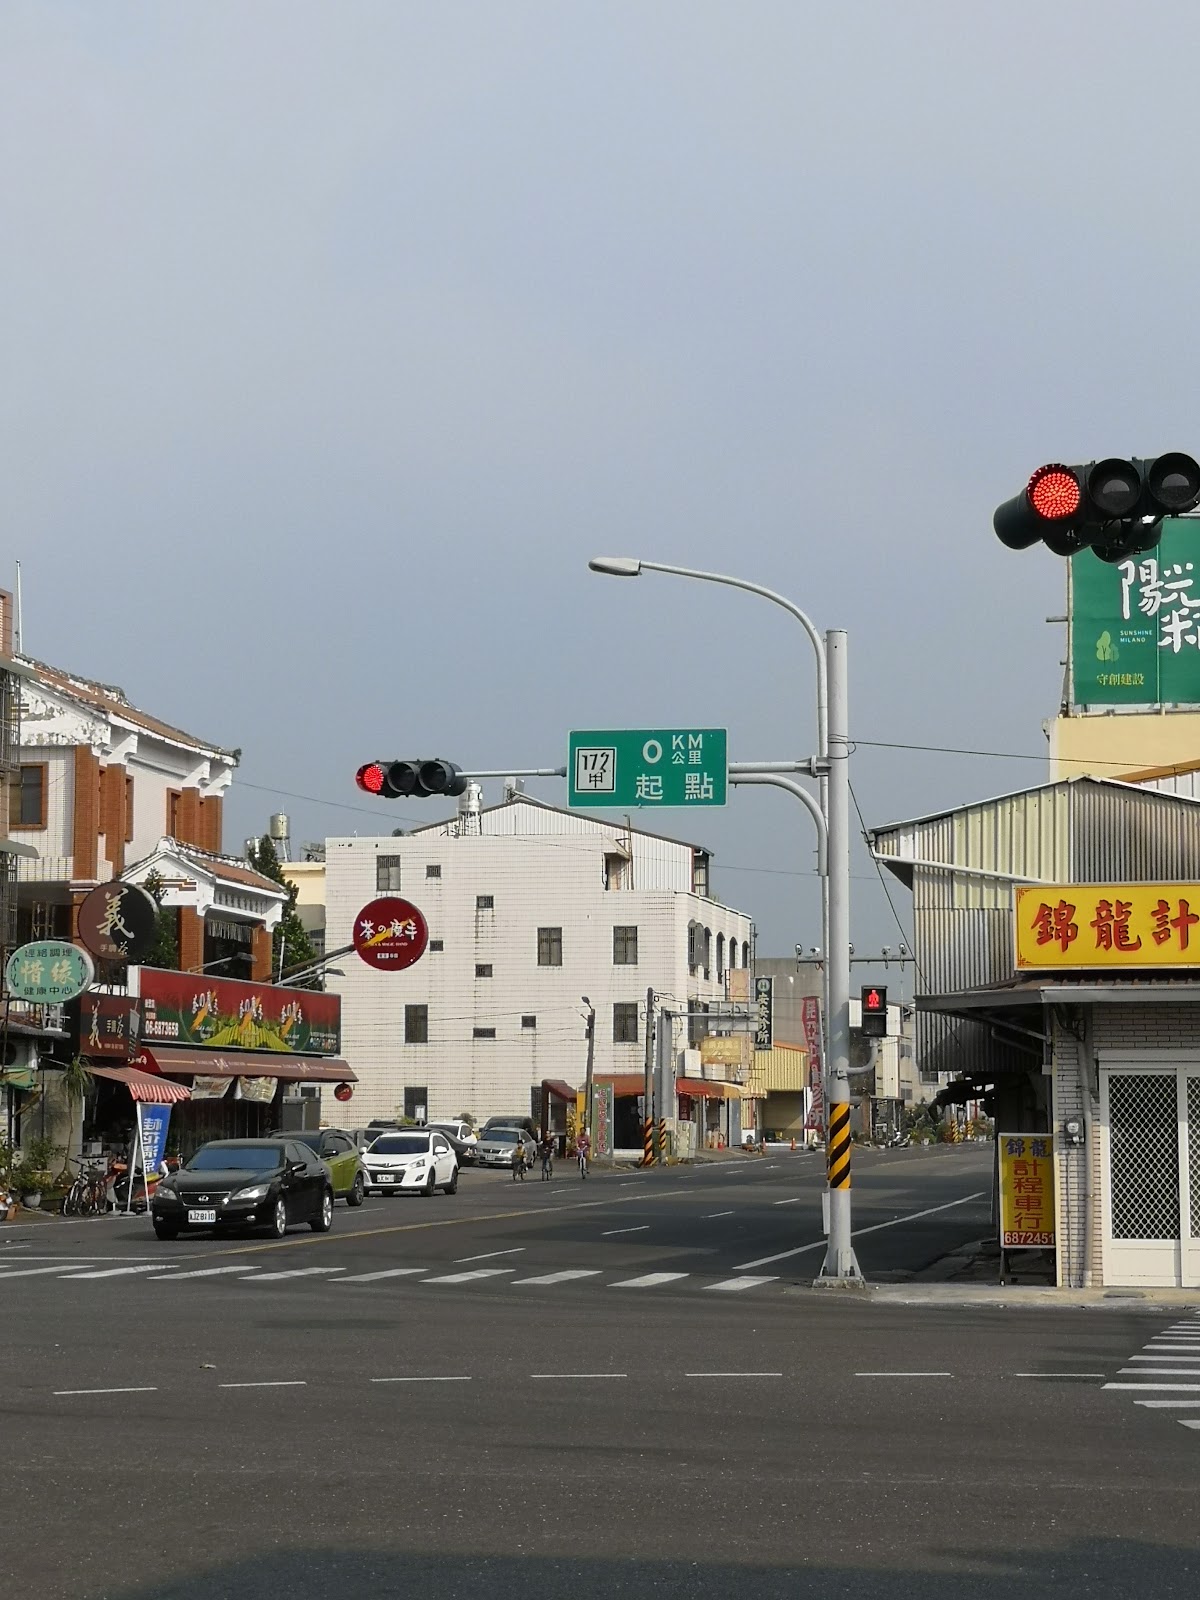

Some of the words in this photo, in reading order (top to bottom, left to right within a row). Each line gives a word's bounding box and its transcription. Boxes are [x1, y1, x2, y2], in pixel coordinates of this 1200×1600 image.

[1096, 673, 1144, 686] 守創建設
[672, 734, 703, 750] KM
[582, 752, 610, 773] 172
[671, 750, 702, 765] 公里
[635, 772, 713, 800] 起點
[96, 887, 135, 939] 義
[360, 918, 418, 941] 茶の魔手
[1030, 899, 1200, 953] 錦龍計
[20, 959, 76, 985] 惜緣
[23, 986, 73, 996] 健康中心
[1005, 1139, 1052, 1158] 錦龍
[1013, 1159, 1044, 1230] 計程車行
[1004, 1232, 1055, 1244] 6872451
